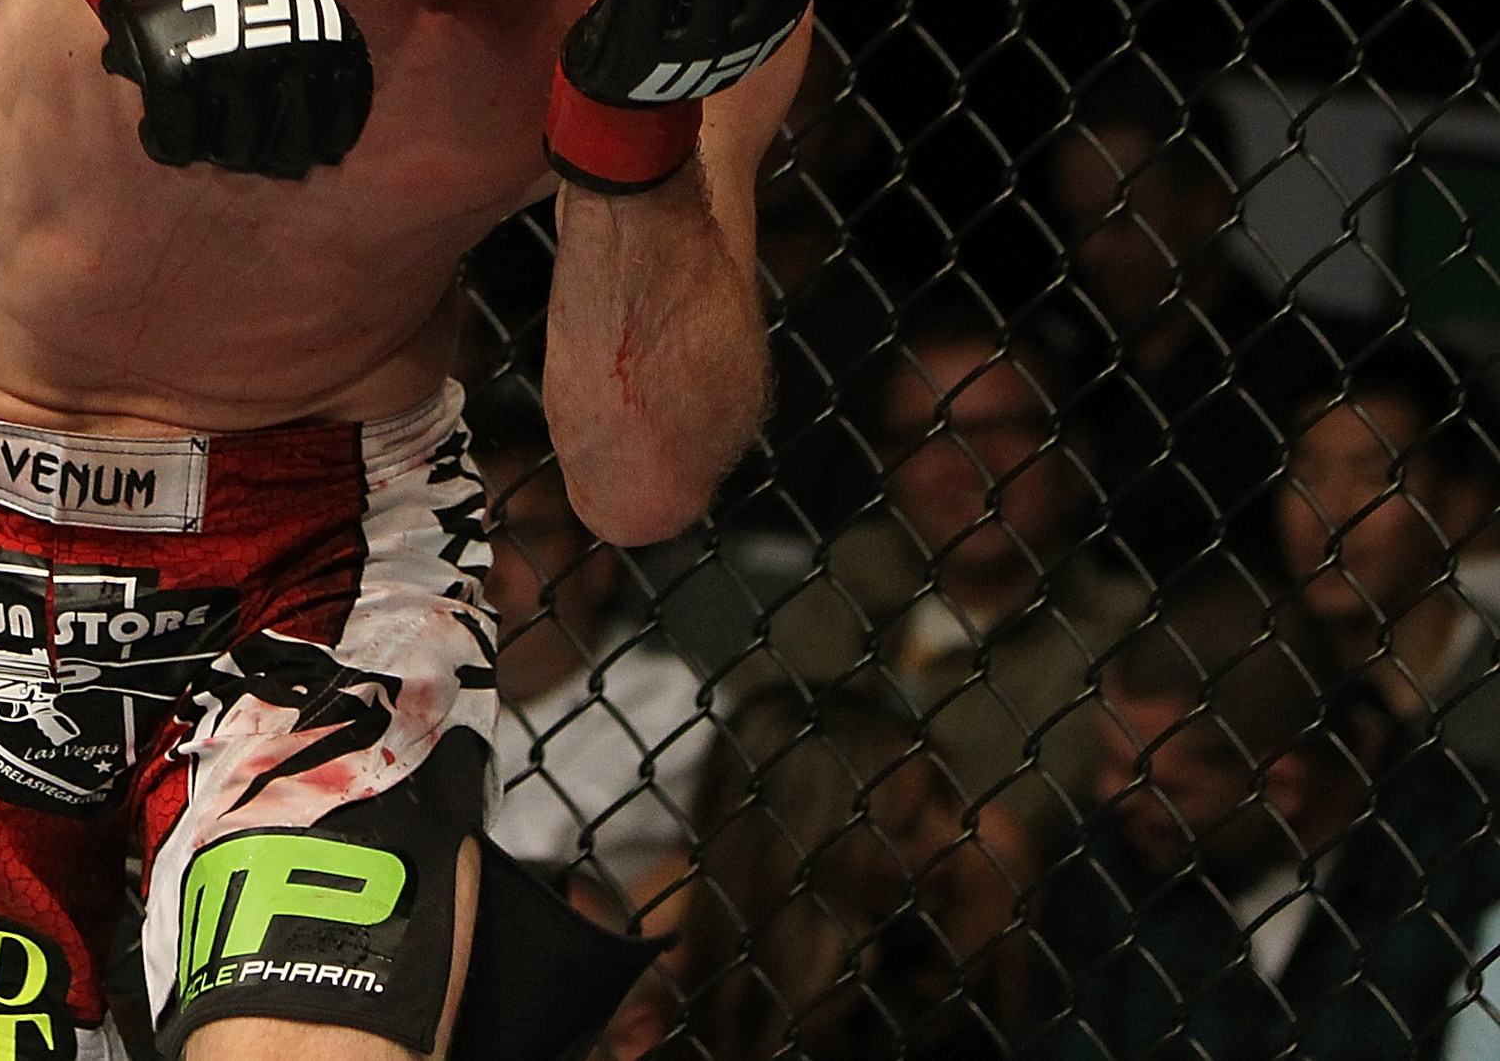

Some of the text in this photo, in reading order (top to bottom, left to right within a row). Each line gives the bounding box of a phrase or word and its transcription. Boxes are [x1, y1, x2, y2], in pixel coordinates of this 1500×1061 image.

[1, 440, 157, 509] VENUM
[54, 604, 211, 646] STORE
[23, 743, 119, 761] Las Vegas
